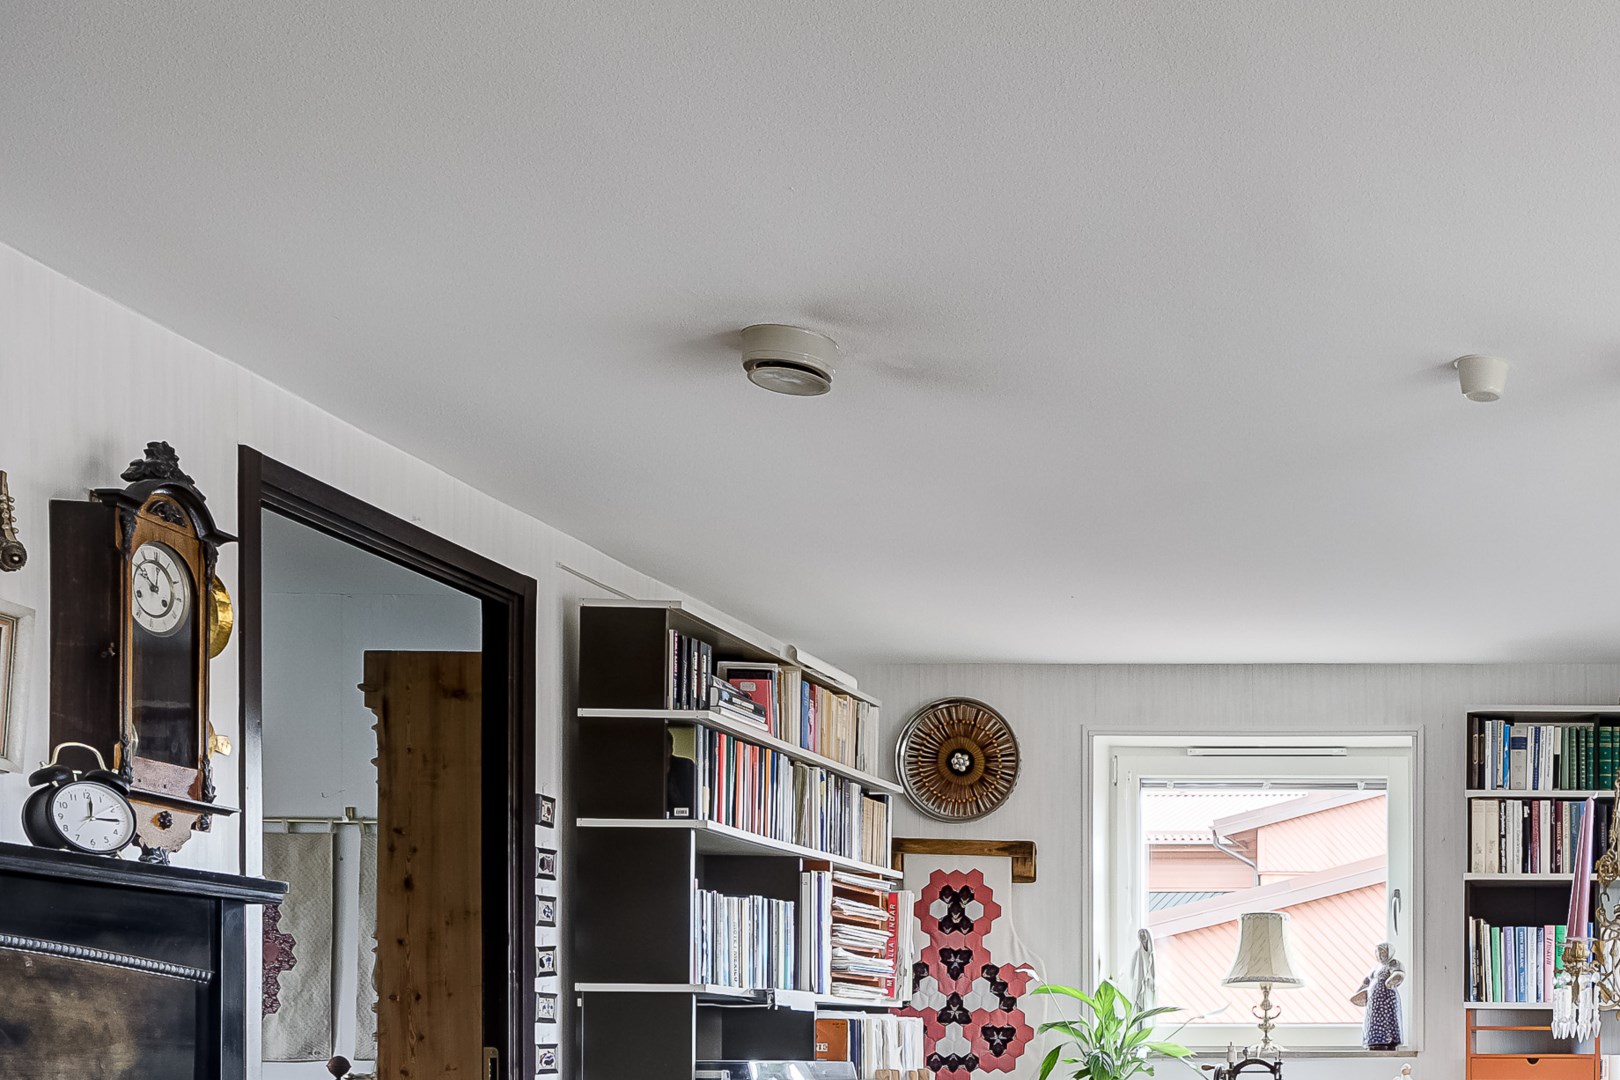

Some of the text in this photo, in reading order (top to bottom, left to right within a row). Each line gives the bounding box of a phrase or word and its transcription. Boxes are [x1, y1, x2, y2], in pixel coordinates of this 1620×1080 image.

[69, 793, 77, 801] 11
[82, 791, 91, 800] 12
[59, 801, 68, 809] 10
[62, 824, 69, 832] 8
[113, 828, 118, 836] 4
[75, 834, 80, 842] 7
[104, 836, 109, 844] 5
